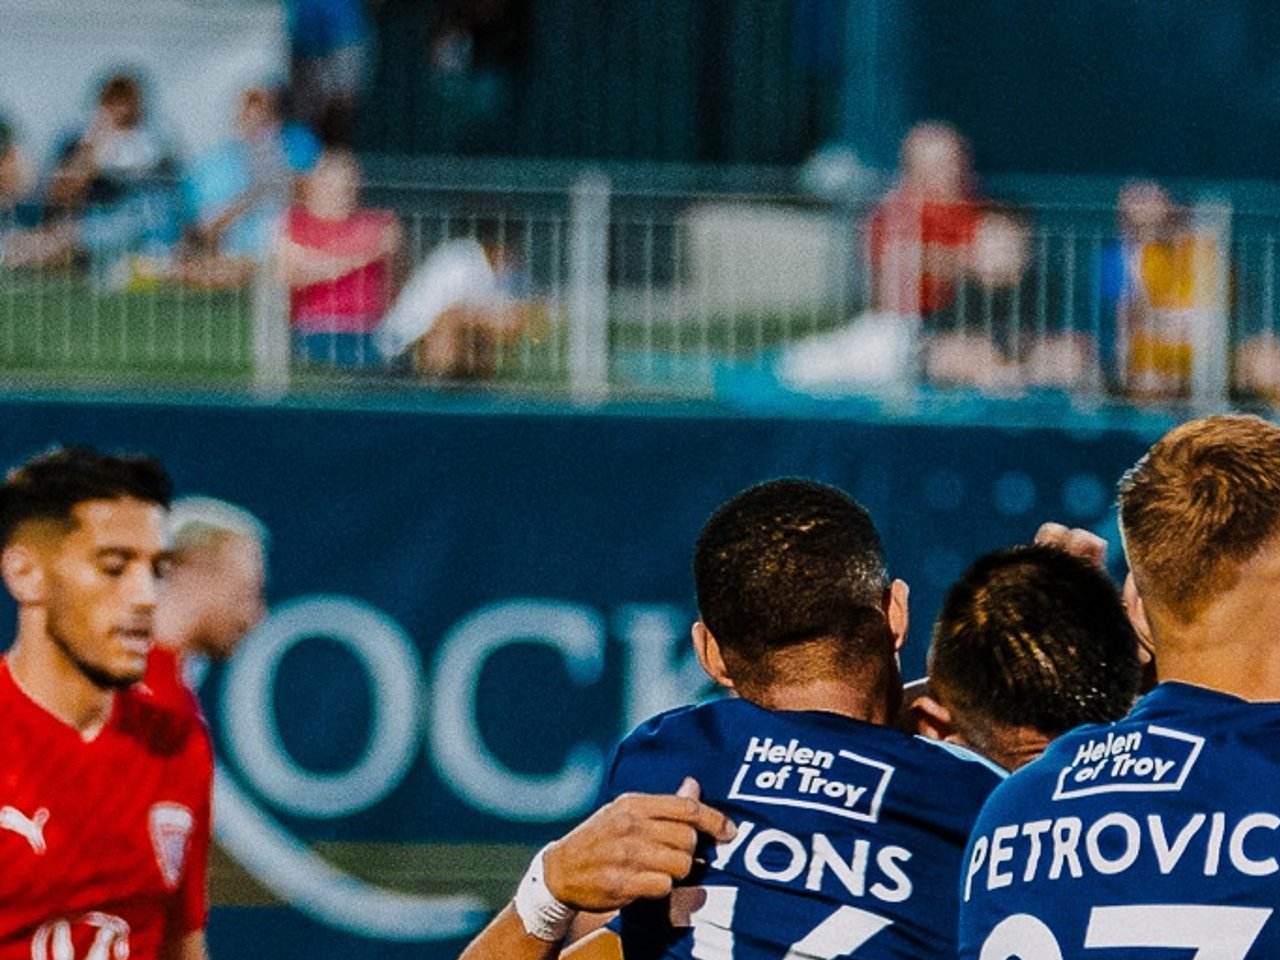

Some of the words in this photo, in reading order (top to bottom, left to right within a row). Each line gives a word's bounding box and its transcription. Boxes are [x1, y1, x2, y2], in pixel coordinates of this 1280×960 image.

[744, 736, 834, 769] Helen
[1072, 731, 1142, 767] Helen
[754, 765, 793, 790] of
[796, 766, 867, 807] Troy
[1074, 758, 1109, 783] of
[1111, 753, 1176, 781] Troy
[711, 820, 914, 904] YONS
